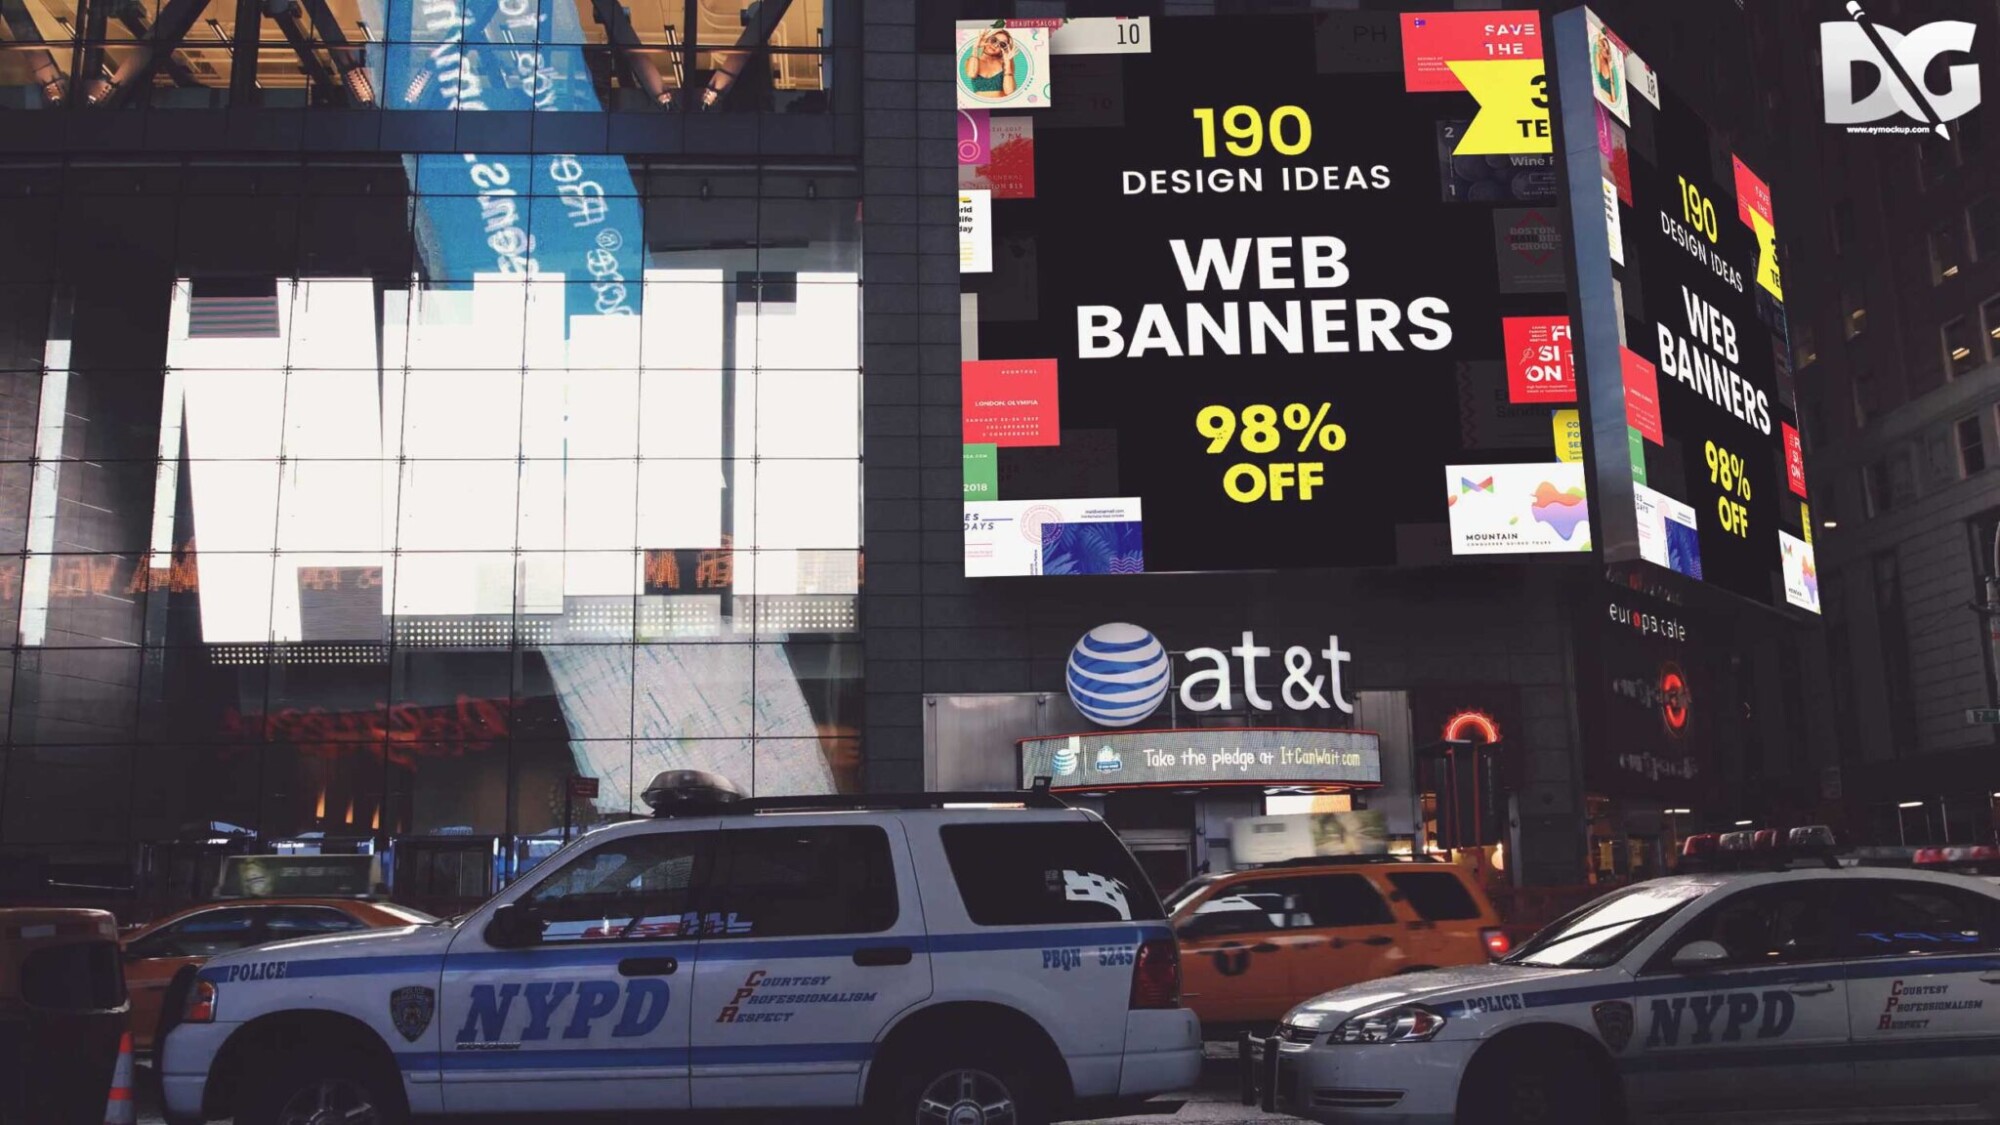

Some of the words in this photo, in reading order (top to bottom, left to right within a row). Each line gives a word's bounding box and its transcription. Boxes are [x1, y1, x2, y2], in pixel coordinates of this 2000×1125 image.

[1116, 23, 1141, 45] 10
[1484, 24, 1536, 36] SAVE
[1485, 42, 1524, 56] THE
[1193, 105, 1313, 158] 190
[1122, 168, 1262, 195] DESIGN
[1282, 164, 1391, 192] IDEAS
[1509, 156, 1545, 167] Wine
[1678, 174, 1718, 244] 190
[1169, 236, 1350, 291] WEB
[1660, 210, 1707, 266] DESIGN
[1711, 253, 1744, 293] IDEAS
[1077, 297, 1453, 359] BANNERS
[1682, 285, 1739, 365] WEB
[1538, 345, 1561, 362] SI
[1525, 365, 1563, 382] ON
[1657, 321, 1771, 436] BANNERS
[1196, 402, 1347, 454] 98%
[963, 483, 988, 492] 2018
[1223, 462, 1324, 503] OFF
[1705, 439, 1751, 501] 98%
[1718, 496, 1748, 539] OFF
[1466, 533, 1519, 541] MOUNTAIN
[1609, 603, 1658, 636] europa
[1180, 631, 1354, 715] at&t
[1142, 749, 1175, 767] Take
[1180, 747, 1206, 766] the
[1211, 747, 1255, 771] pledge
[1259, 750, 1275, 766] at
[229, 961, 286, 982] POLICE
[1041, 948, 1081, 971] PBQN
[1098, 946, 1134, 967] 5245
[455, 978, 671, 1043] NYPD
[1466, 993, 1523, 1014] POLICE
[1646, 989, 1796, 1048] NYPD
